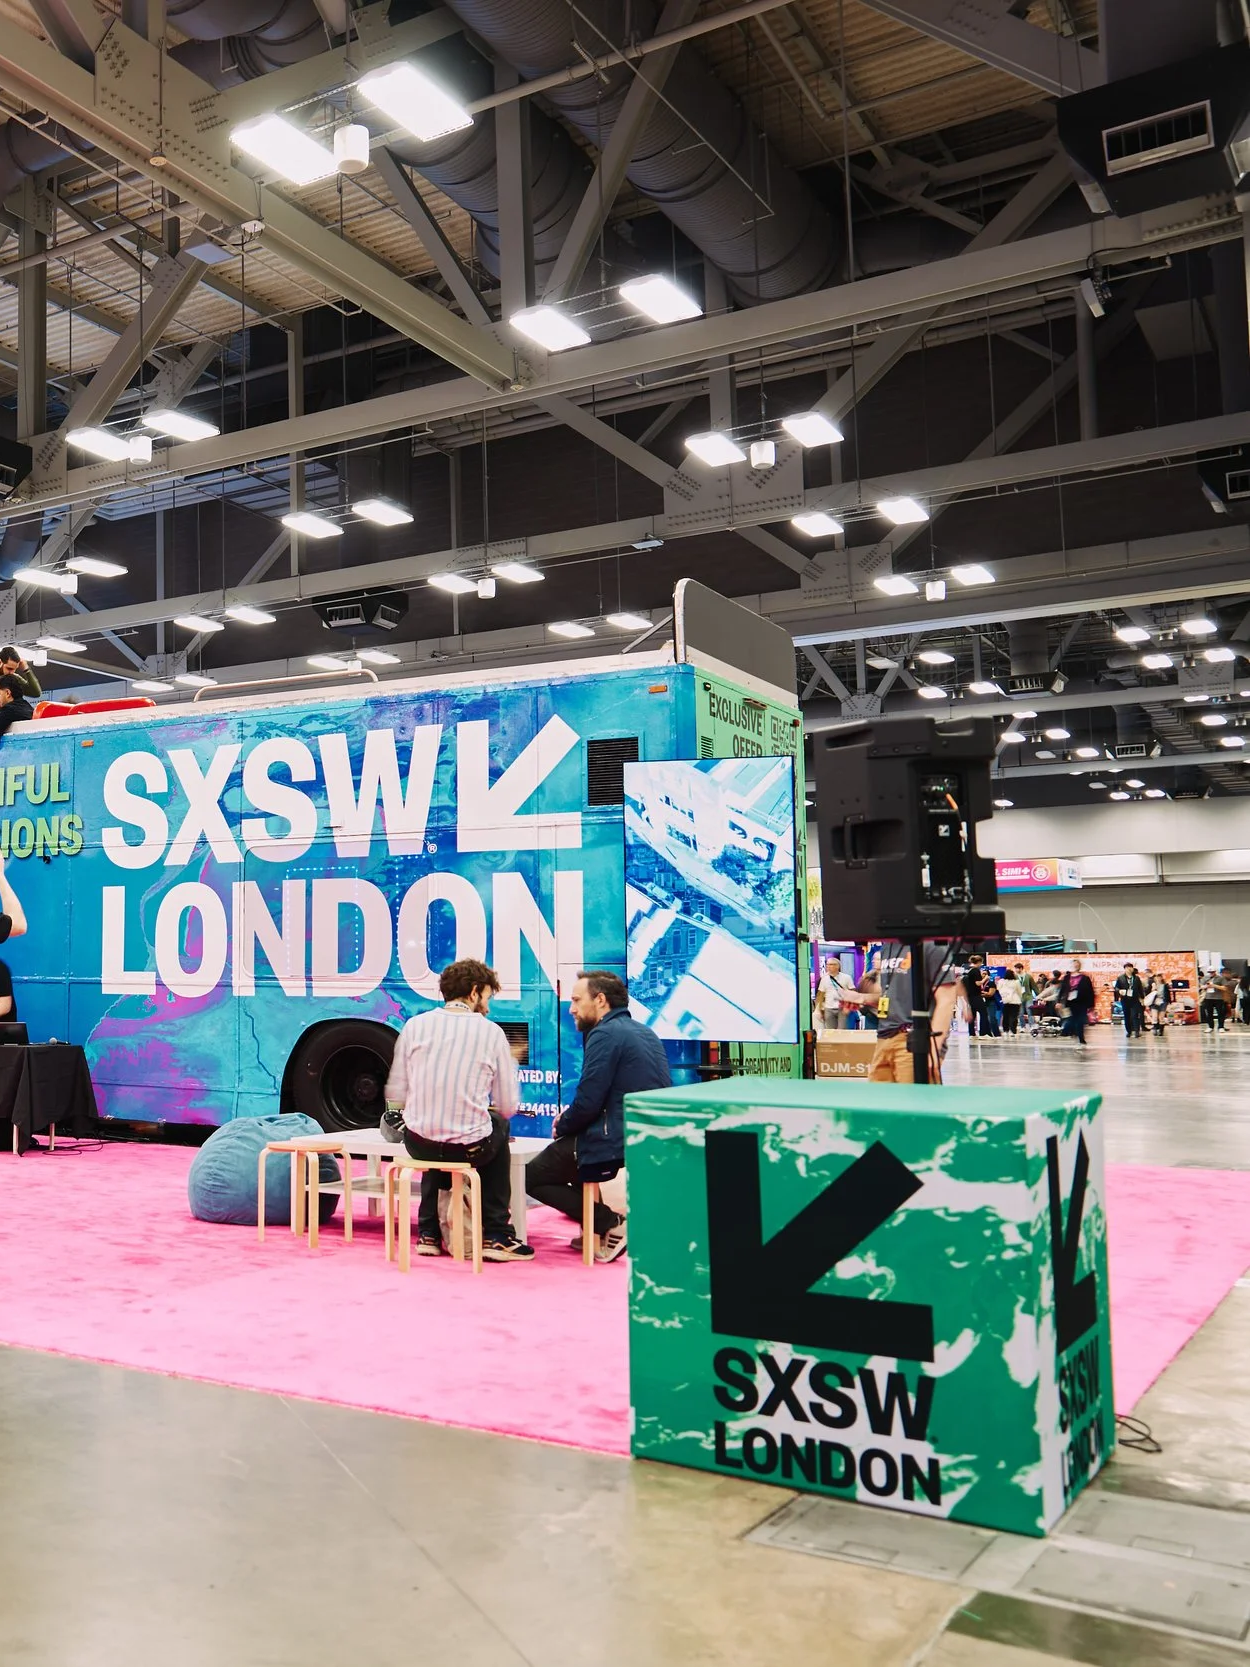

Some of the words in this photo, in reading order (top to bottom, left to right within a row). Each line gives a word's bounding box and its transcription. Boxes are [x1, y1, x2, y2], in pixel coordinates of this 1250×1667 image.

[709, 692, 763, 737] EXCLUSIVE
[101, 724, 443, 869] SXSW
[101, 870, 584, 1001] LONDON
[518, 1069, 543, 1083] ATED
[745, 1057, 780, 1075] CREATIVITY
[779, 1056, 792, 1073] AND
[820, 1062, 871, 1073] DJM-S1
[712, 1346, 937, 1442] SXSW
[1058, 1334, 1100, 1434] SXSW
[713, 1420, 943, 1507] LONDON
[1061, 1406, 1105, 1496] LONDON
